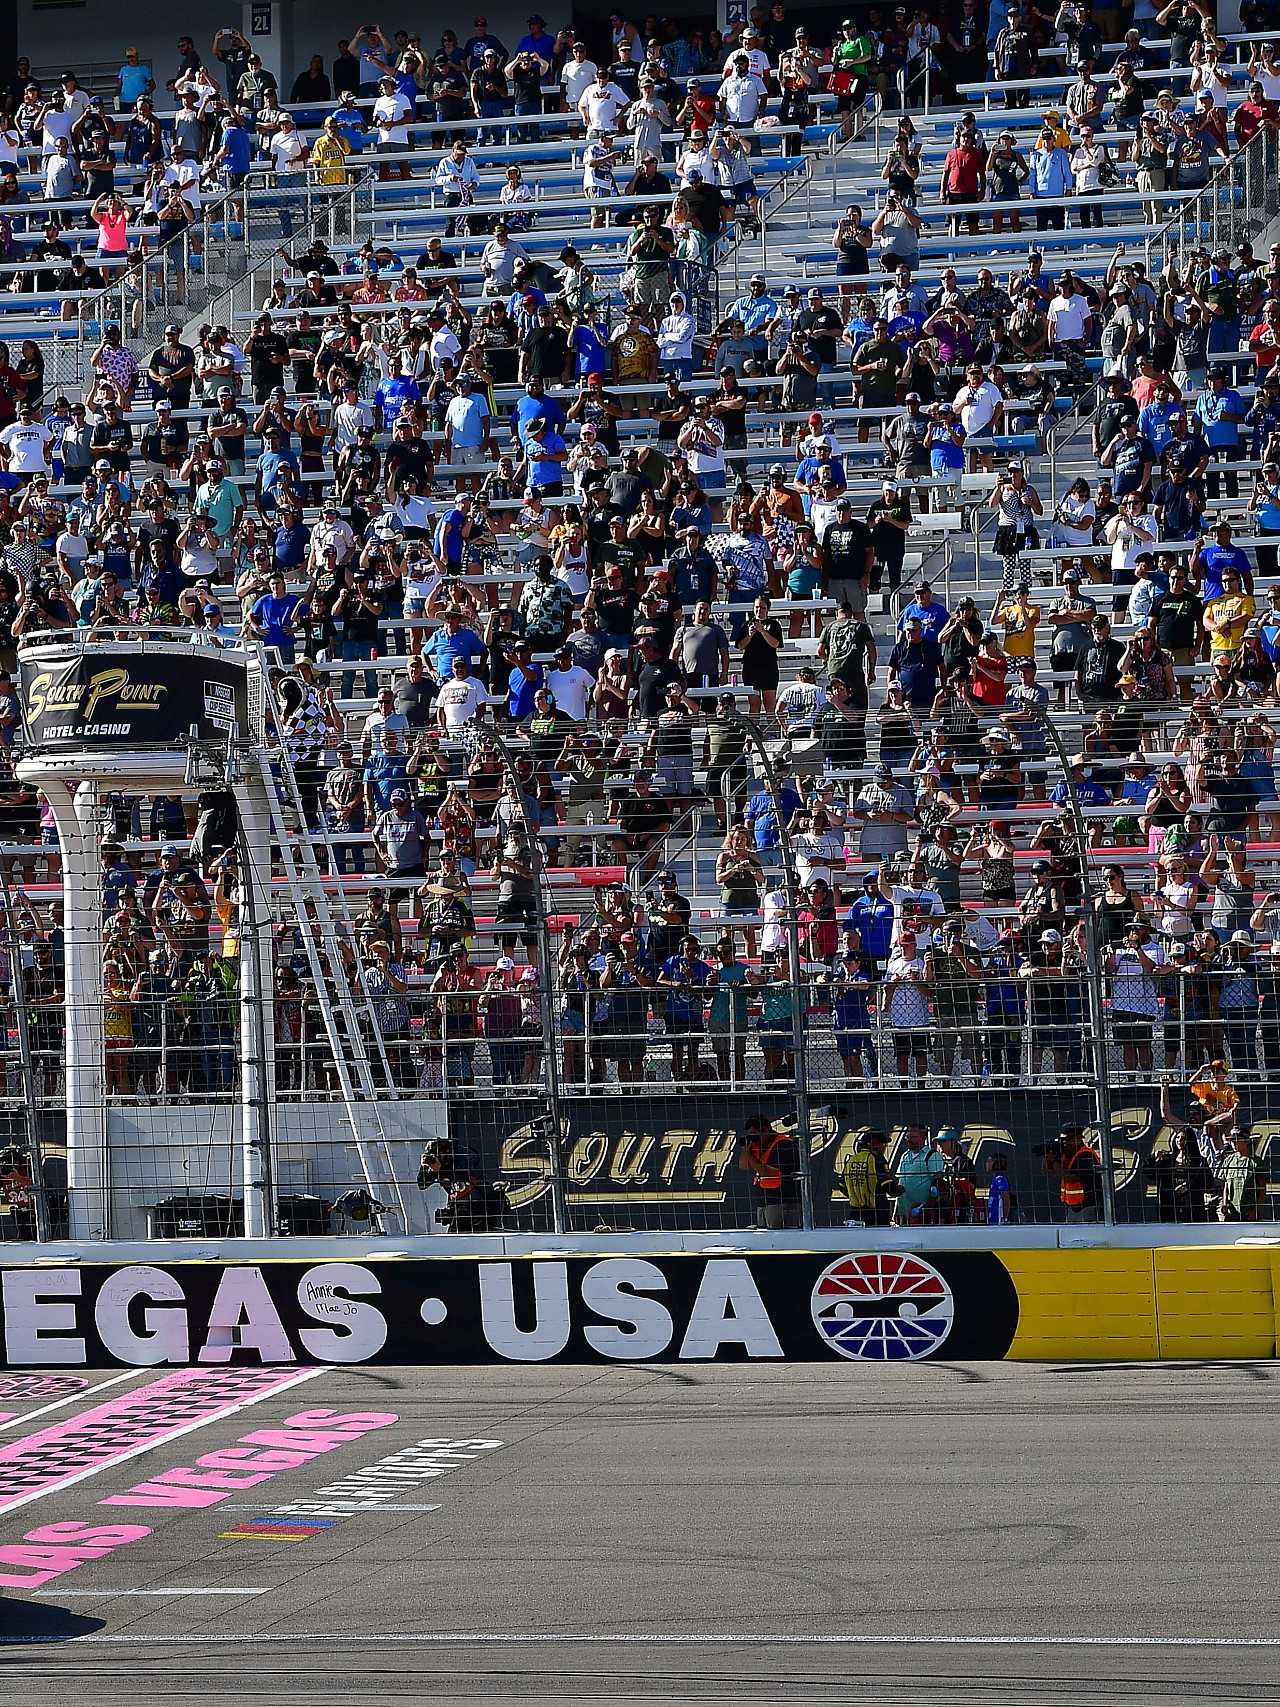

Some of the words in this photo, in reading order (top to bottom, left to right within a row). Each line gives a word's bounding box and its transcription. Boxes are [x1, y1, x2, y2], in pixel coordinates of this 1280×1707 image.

[254, 17, 269, 30] 2L
[28, 672, 84, 724] SOUTH
[83, 668, 168, 720] POINT
[42, 725, 75, 740] HOTEL
[76, 726, 83, 735] &
[84, 723, 131, 737] CASINO
[500, 1117, 738, 1209] SOUTH
[477, 1258, 785, 1362] USA
[98, 1408, 401, 1508] VEGAS
